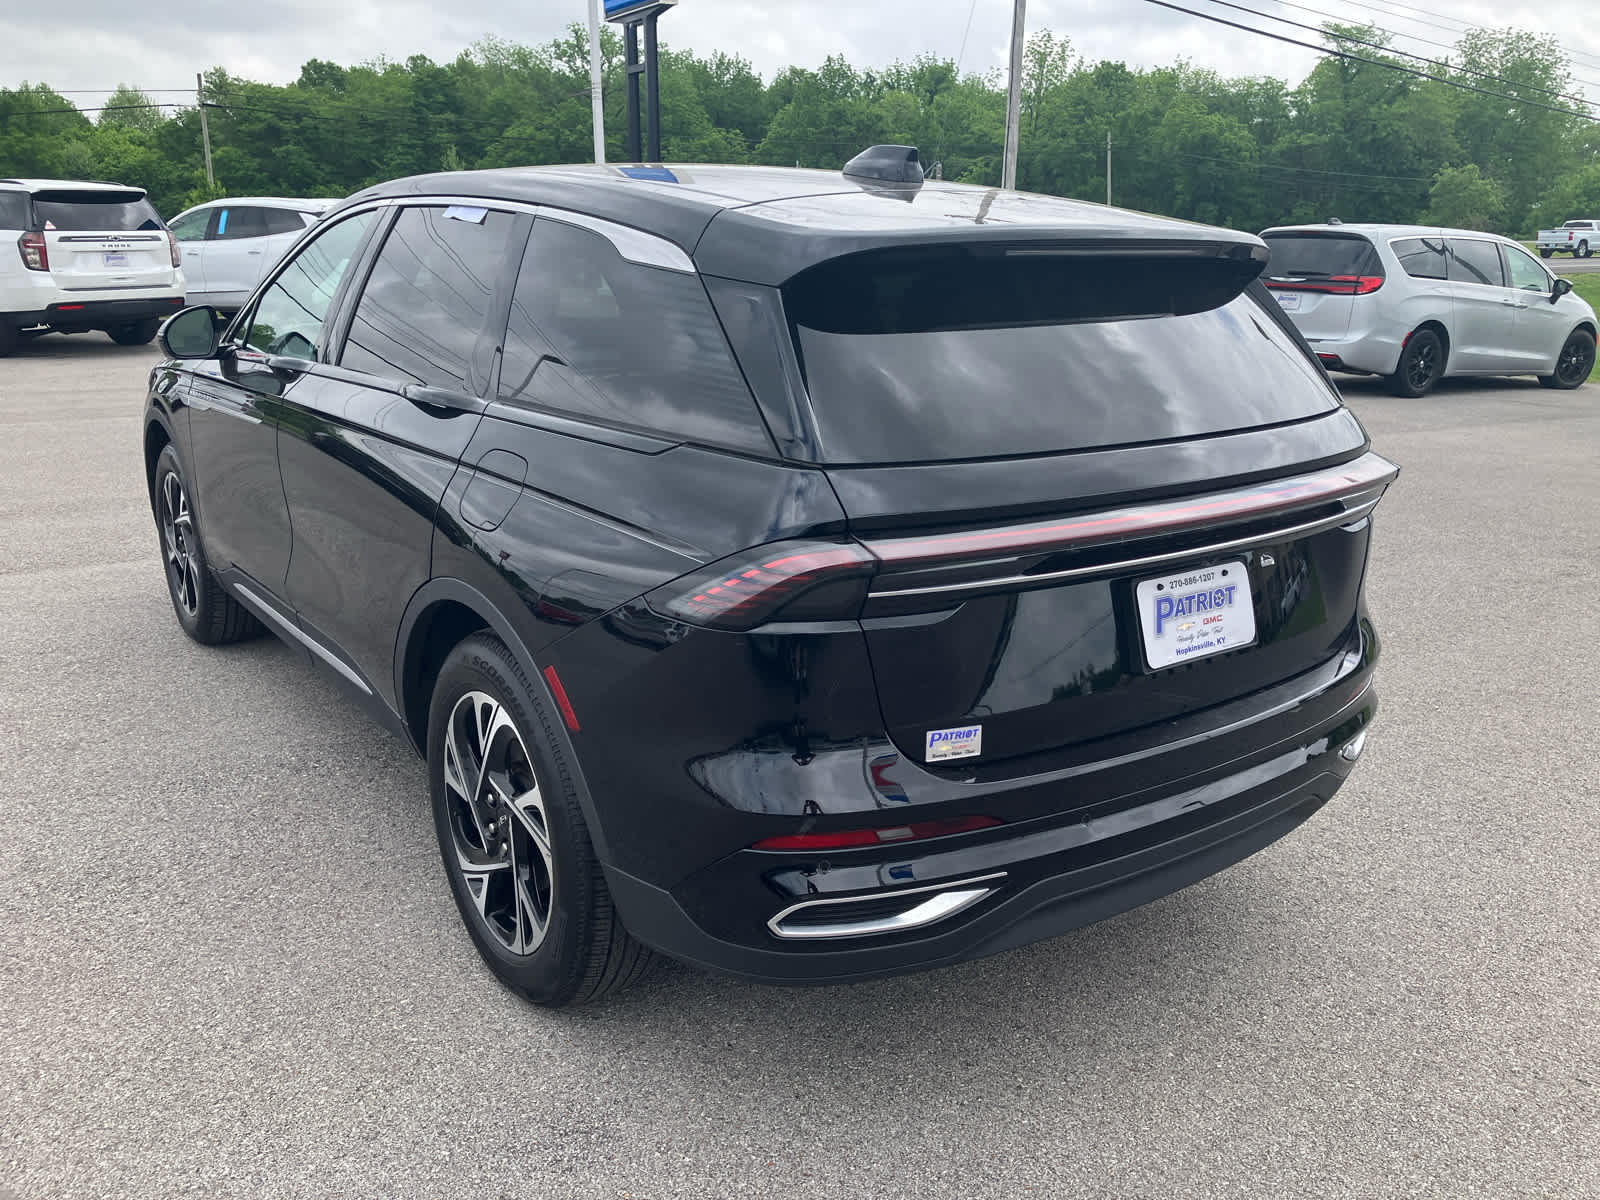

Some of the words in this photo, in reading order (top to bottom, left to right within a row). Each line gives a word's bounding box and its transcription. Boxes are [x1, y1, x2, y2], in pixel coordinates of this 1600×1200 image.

[1169, 572, 1215, 589] 270-886-1207
[1155, 585, 1236, 634] PATRIOT
[1203, 615, 1223, 625] GMC
[1176, 640, 1216, 656] Hopkinsville,
[1217, 636, 1226, 645] KY
[929, 728, 979, 748] PATRIOT
